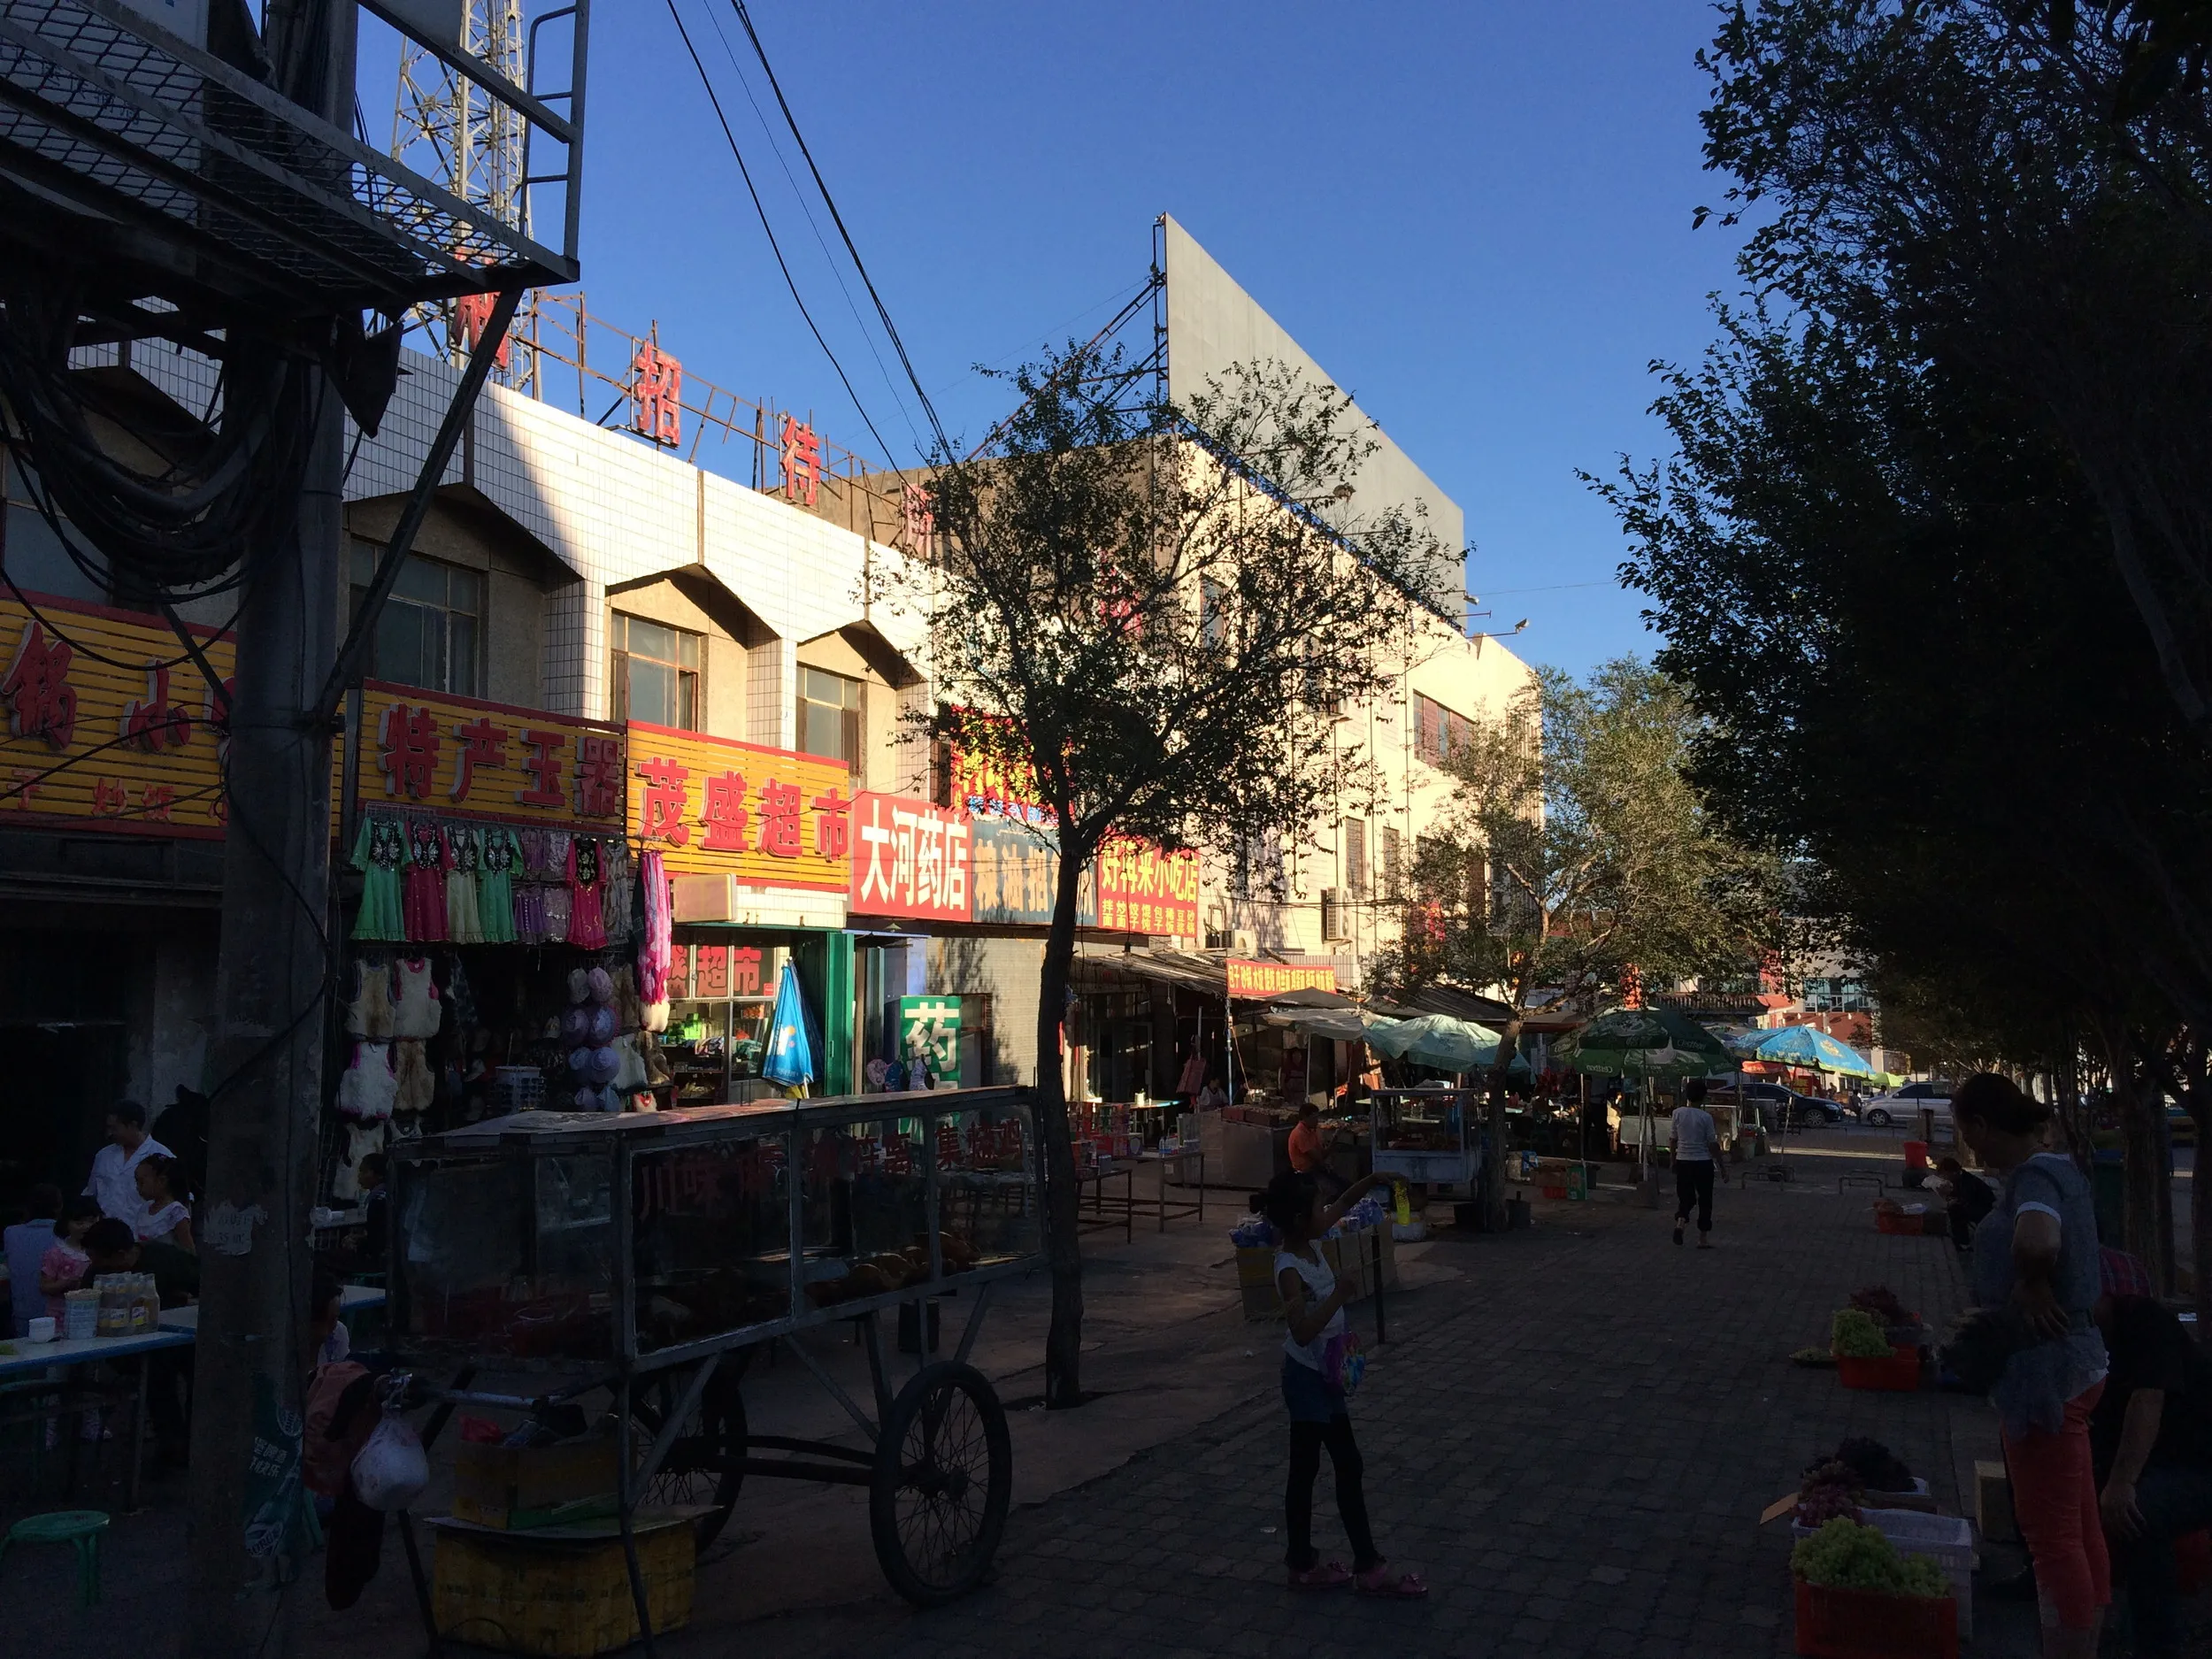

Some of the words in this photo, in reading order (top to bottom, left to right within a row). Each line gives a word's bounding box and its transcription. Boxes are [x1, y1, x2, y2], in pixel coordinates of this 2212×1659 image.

[378, 703, 619, 819] 特产玉器
[634, 757, 852, 863] 茂盛超市
[860, 799, 968, 911] 大河药店
[1101, 840, 1199, 904] 好再来小吃店
[905, 1002, 960, 1091] 药
